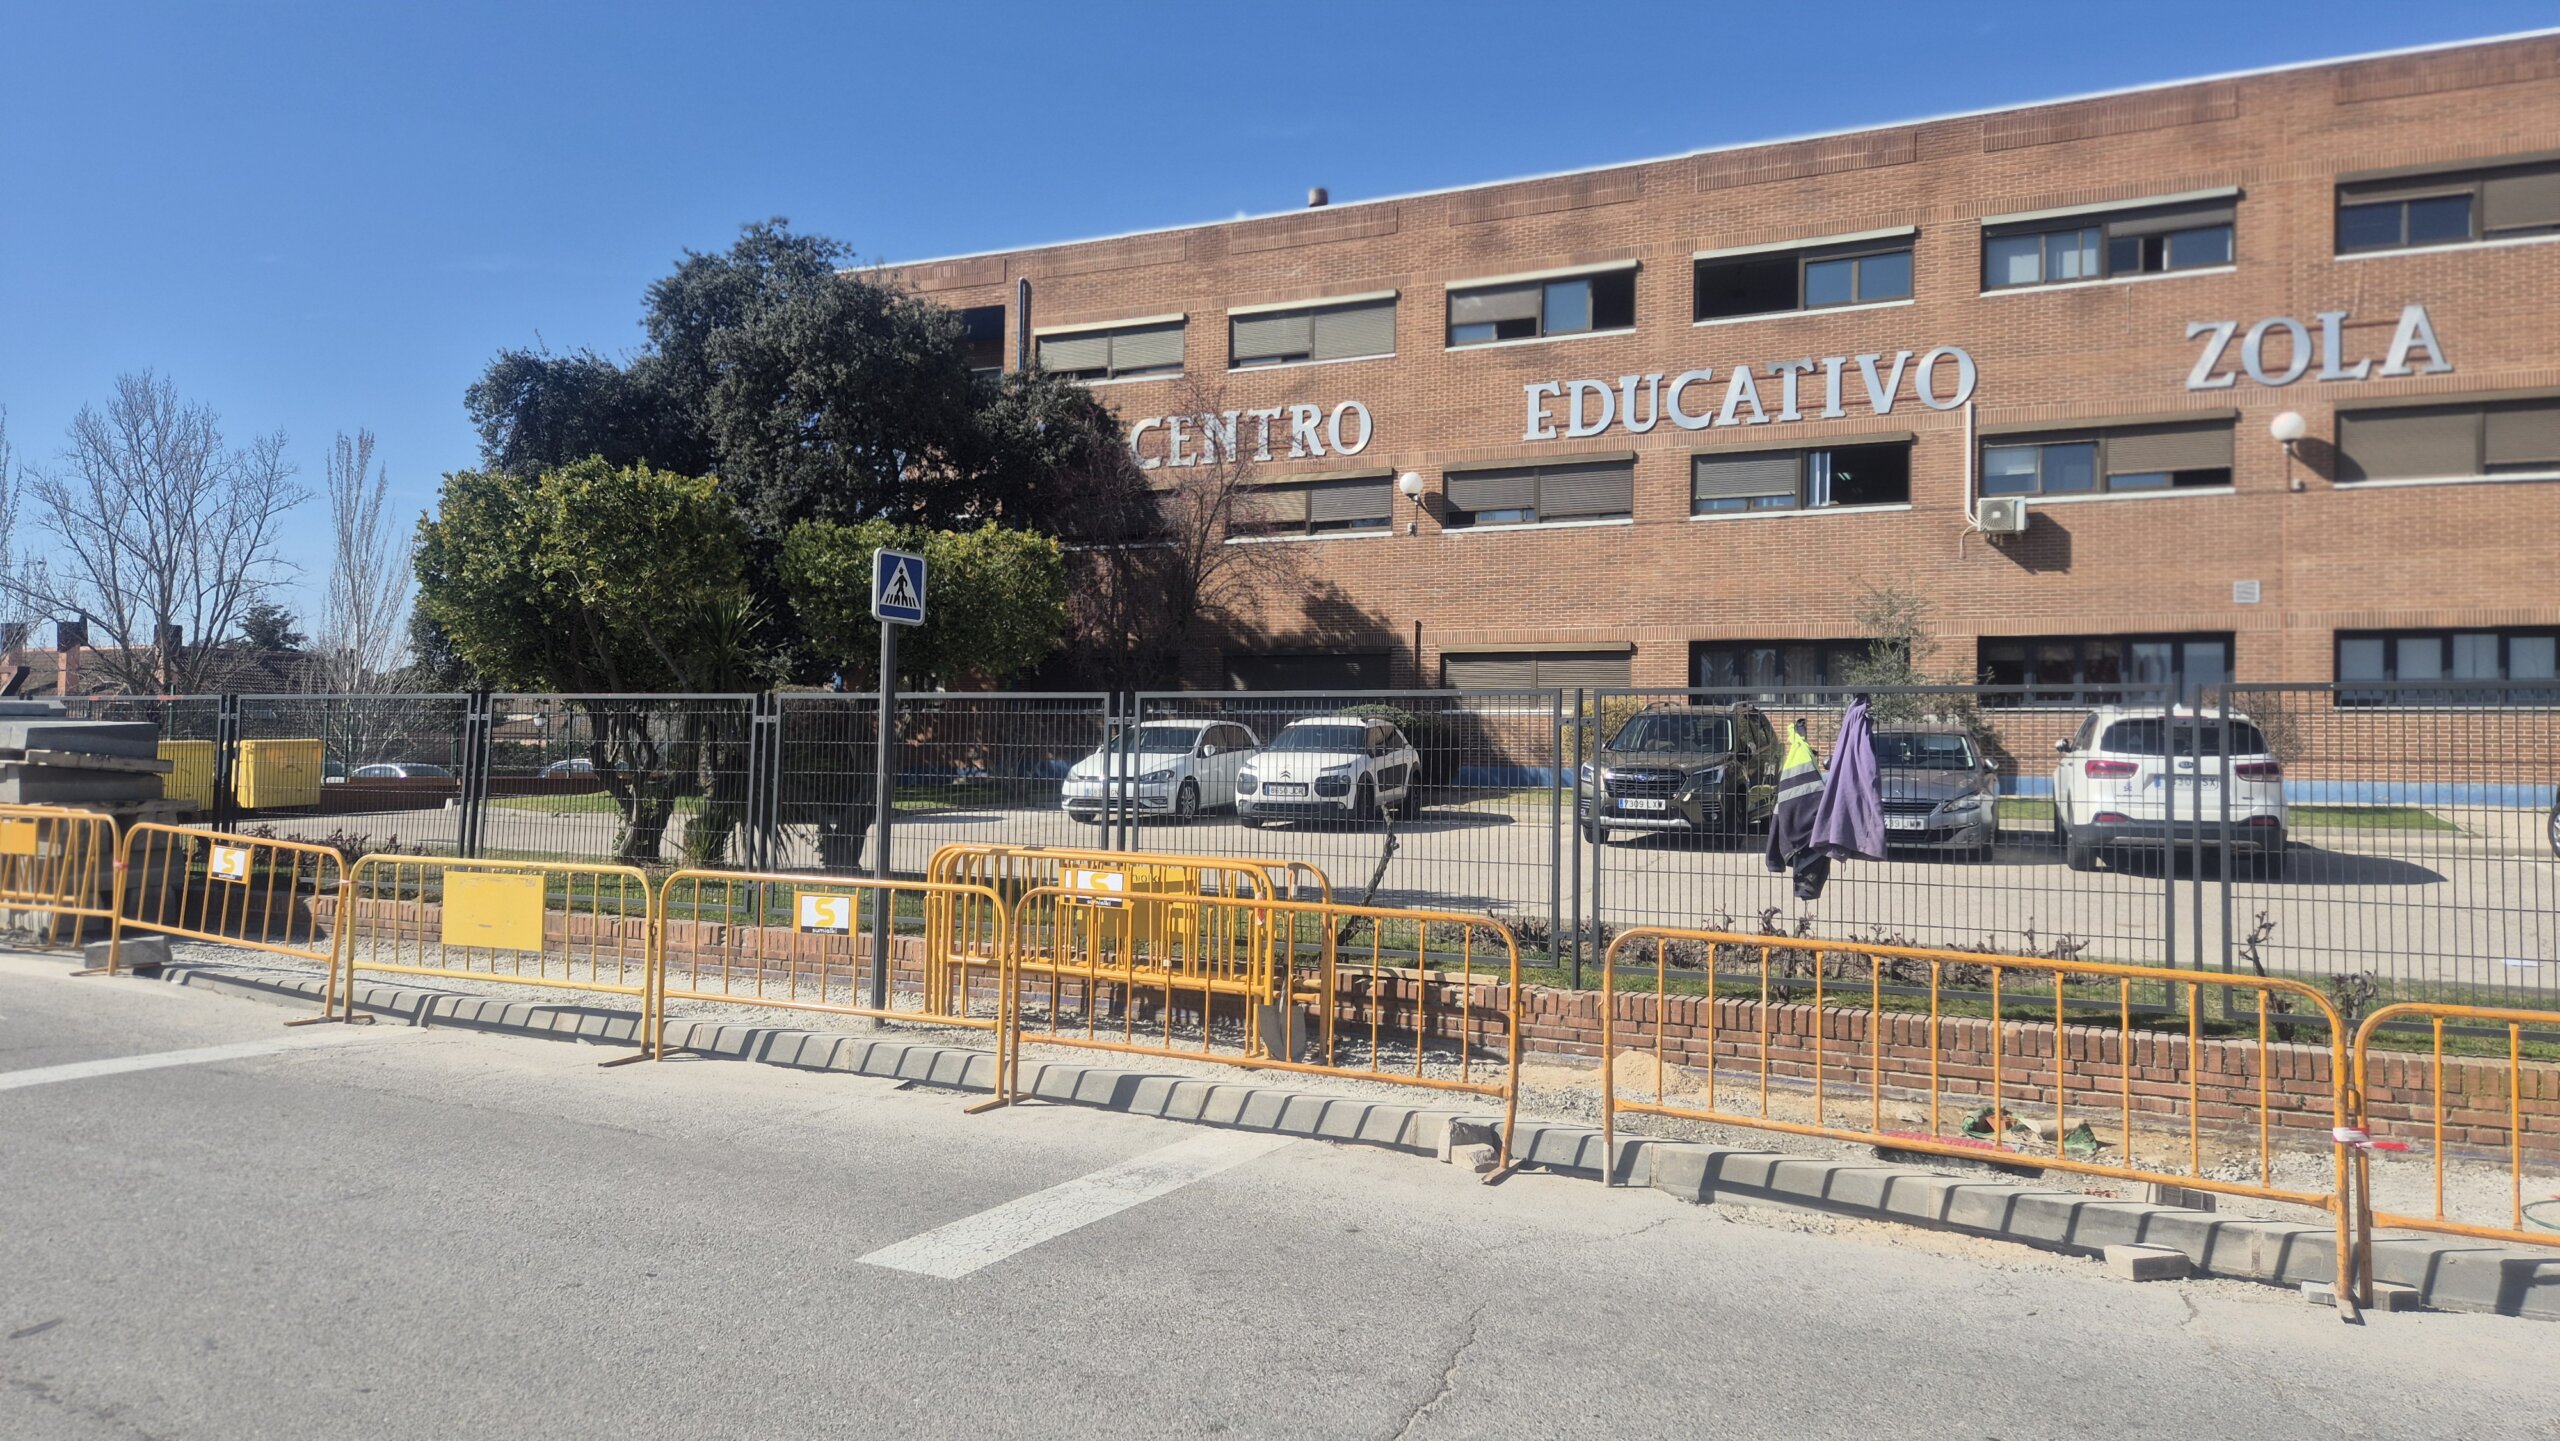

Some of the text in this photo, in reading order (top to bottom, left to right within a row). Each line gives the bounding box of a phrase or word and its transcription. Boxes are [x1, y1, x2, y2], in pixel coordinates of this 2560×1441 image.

[1129, 304, 2454, 470] CENTRO EDUCATIVO ZOLA
[1625, 799, 1645, 808] 7309
[815, 898, 836, 927] S
